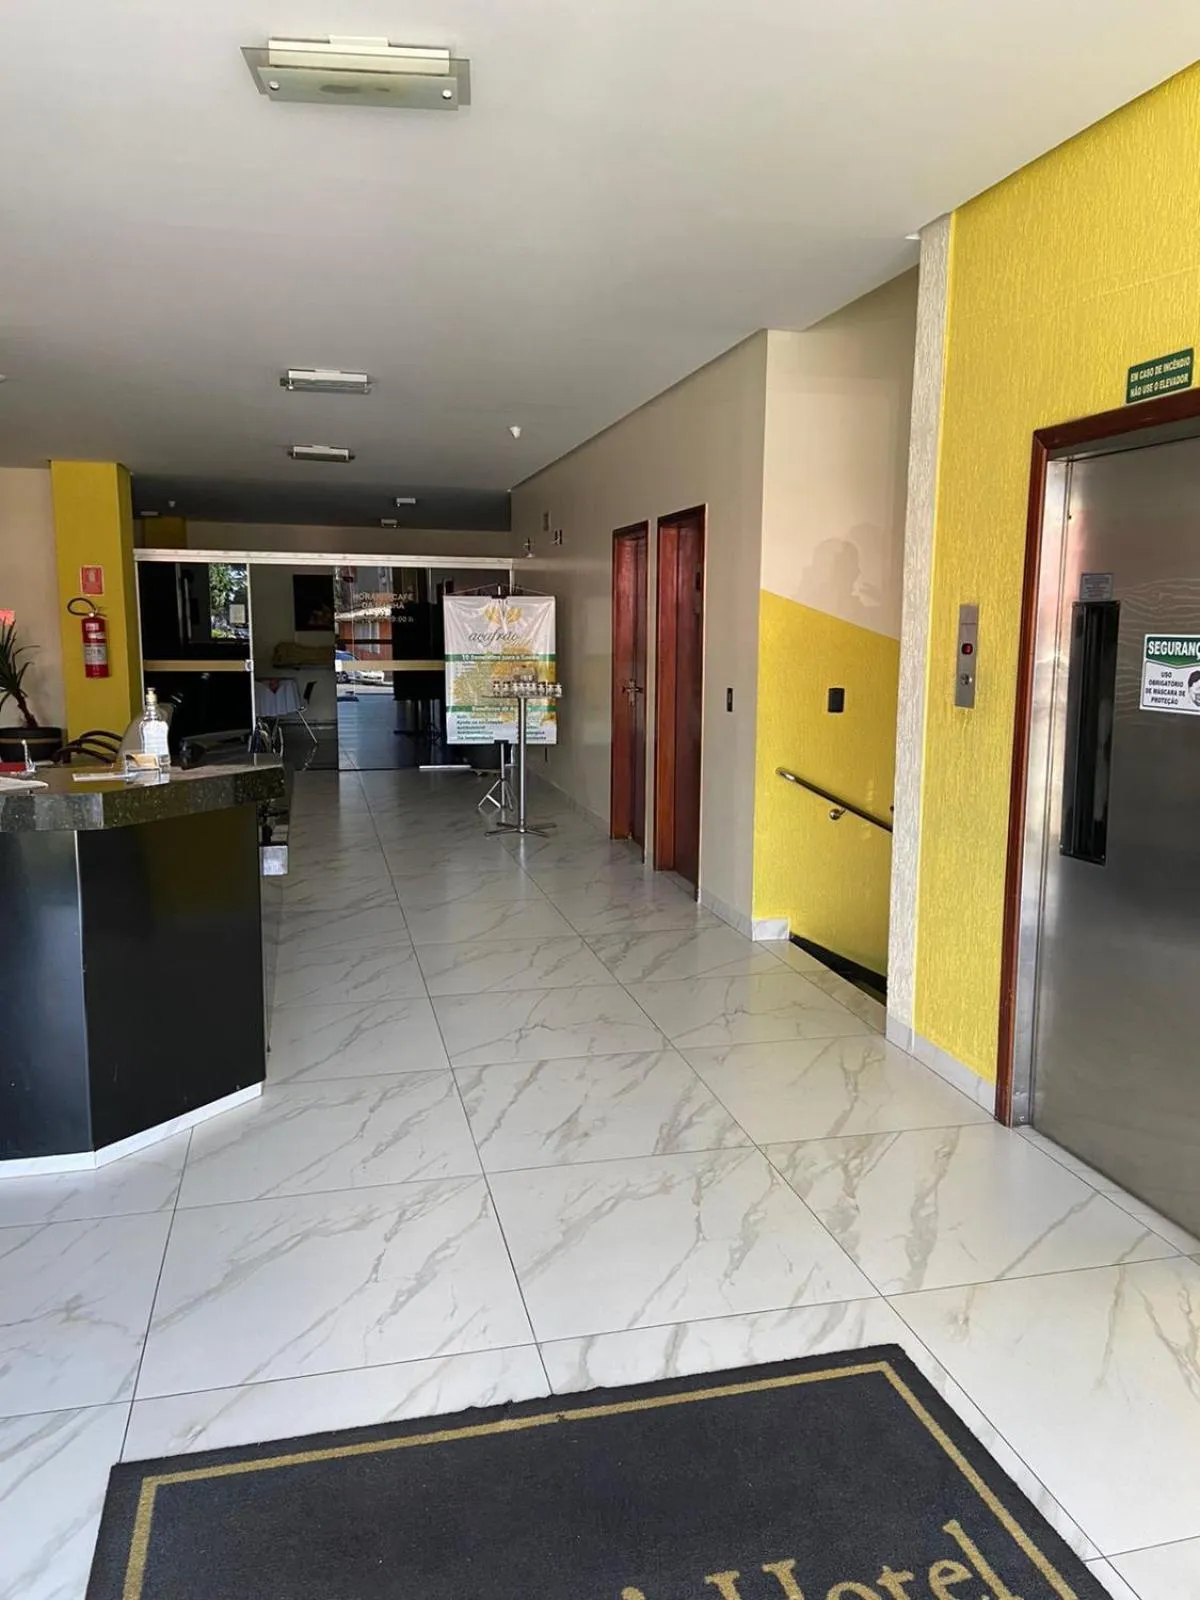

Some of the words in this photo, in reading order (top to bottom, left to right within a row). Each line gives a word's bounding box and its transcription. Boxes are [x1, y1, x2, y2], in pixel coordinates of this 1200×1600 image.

[1130, 372, 1138, 382] EM
[1139, 367, 1154, 379] CASO
[1154, 364, 1162, 375] DE
[1142, 383, 1153, 394] USE
[1159, 373, 1188, 388] ELEVADOR
[1148, 640, 1200, 661] SEGURANÇ
